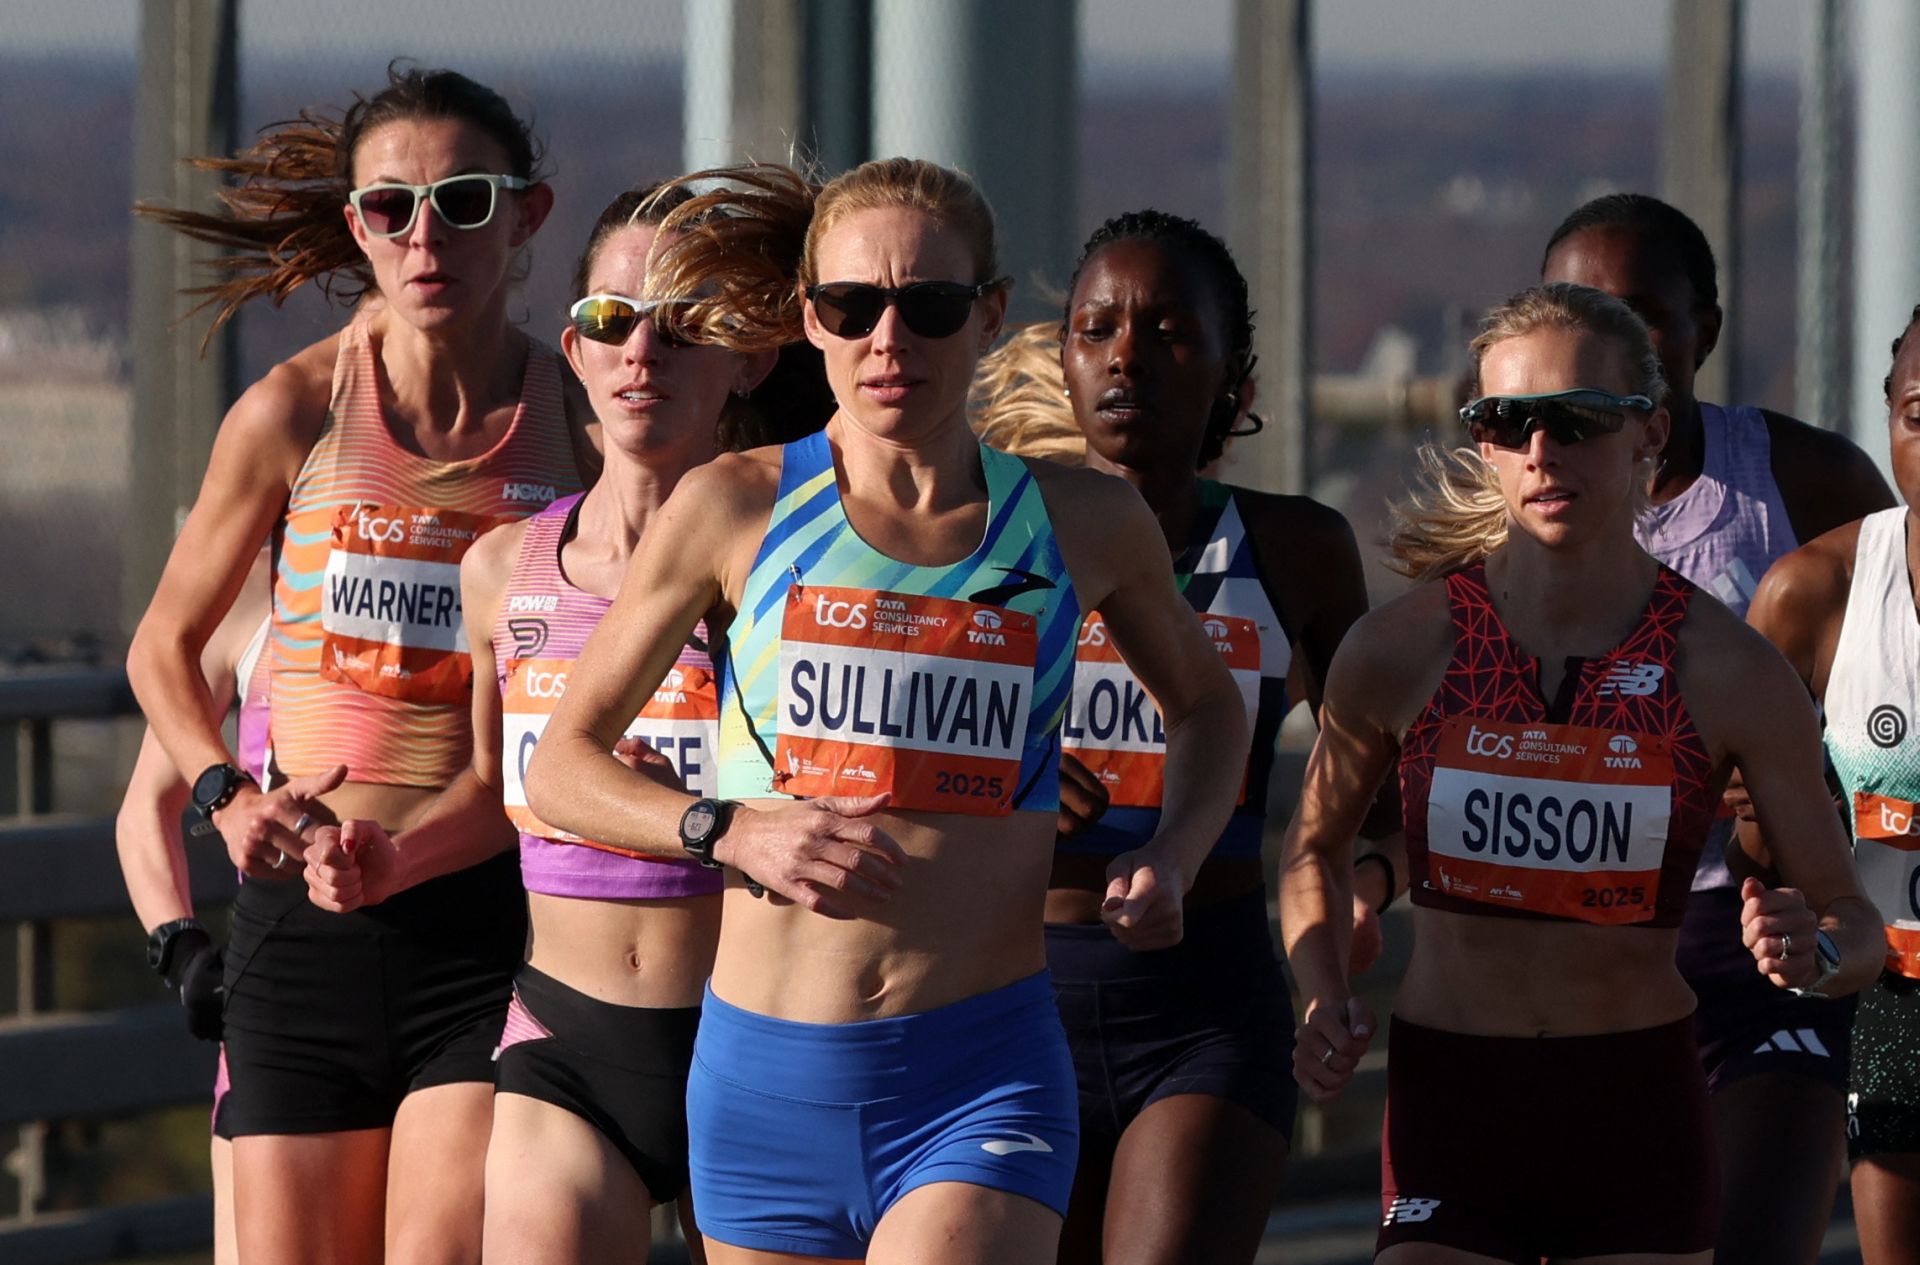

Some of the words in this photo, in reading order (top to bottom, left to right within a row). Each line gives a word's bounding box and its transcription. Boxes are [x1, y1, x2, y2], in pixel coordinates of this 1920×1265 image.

[502, 483, 556, 501] HOKA
[357, 511, 405, 543] tcs
[411, 514, 440, 526] TATA
[410, 525, 477, 541] CONSULTANCY
[409, 535, 452, 549] SERVICES
[815, 594, 868, 630] tcs
[875, 599, 906, 610] TATA
[873, 610, 948, 628] CONSULTANCY
[872, 621, 920, 636] SERVICES
[967, 631, 1006, 646] TATA
[527, 666, 567, 698] tcs
[789, 659, 1020, 749] SULLIVAN
[1467, 725, 1514, 759] tcs
[1522, 731, 1547, 740] TATA
[1519, 740, 1587, 755] CONSULTANCY
[1515, 751, 1560, 764] SERVICES
[1604, 757, 1642, 769] TATA
[935, 771, 1004, 798] 2025
[1462, 788, 1633, 864] SISSON
[1581, 886, 1646, 908] 2025
